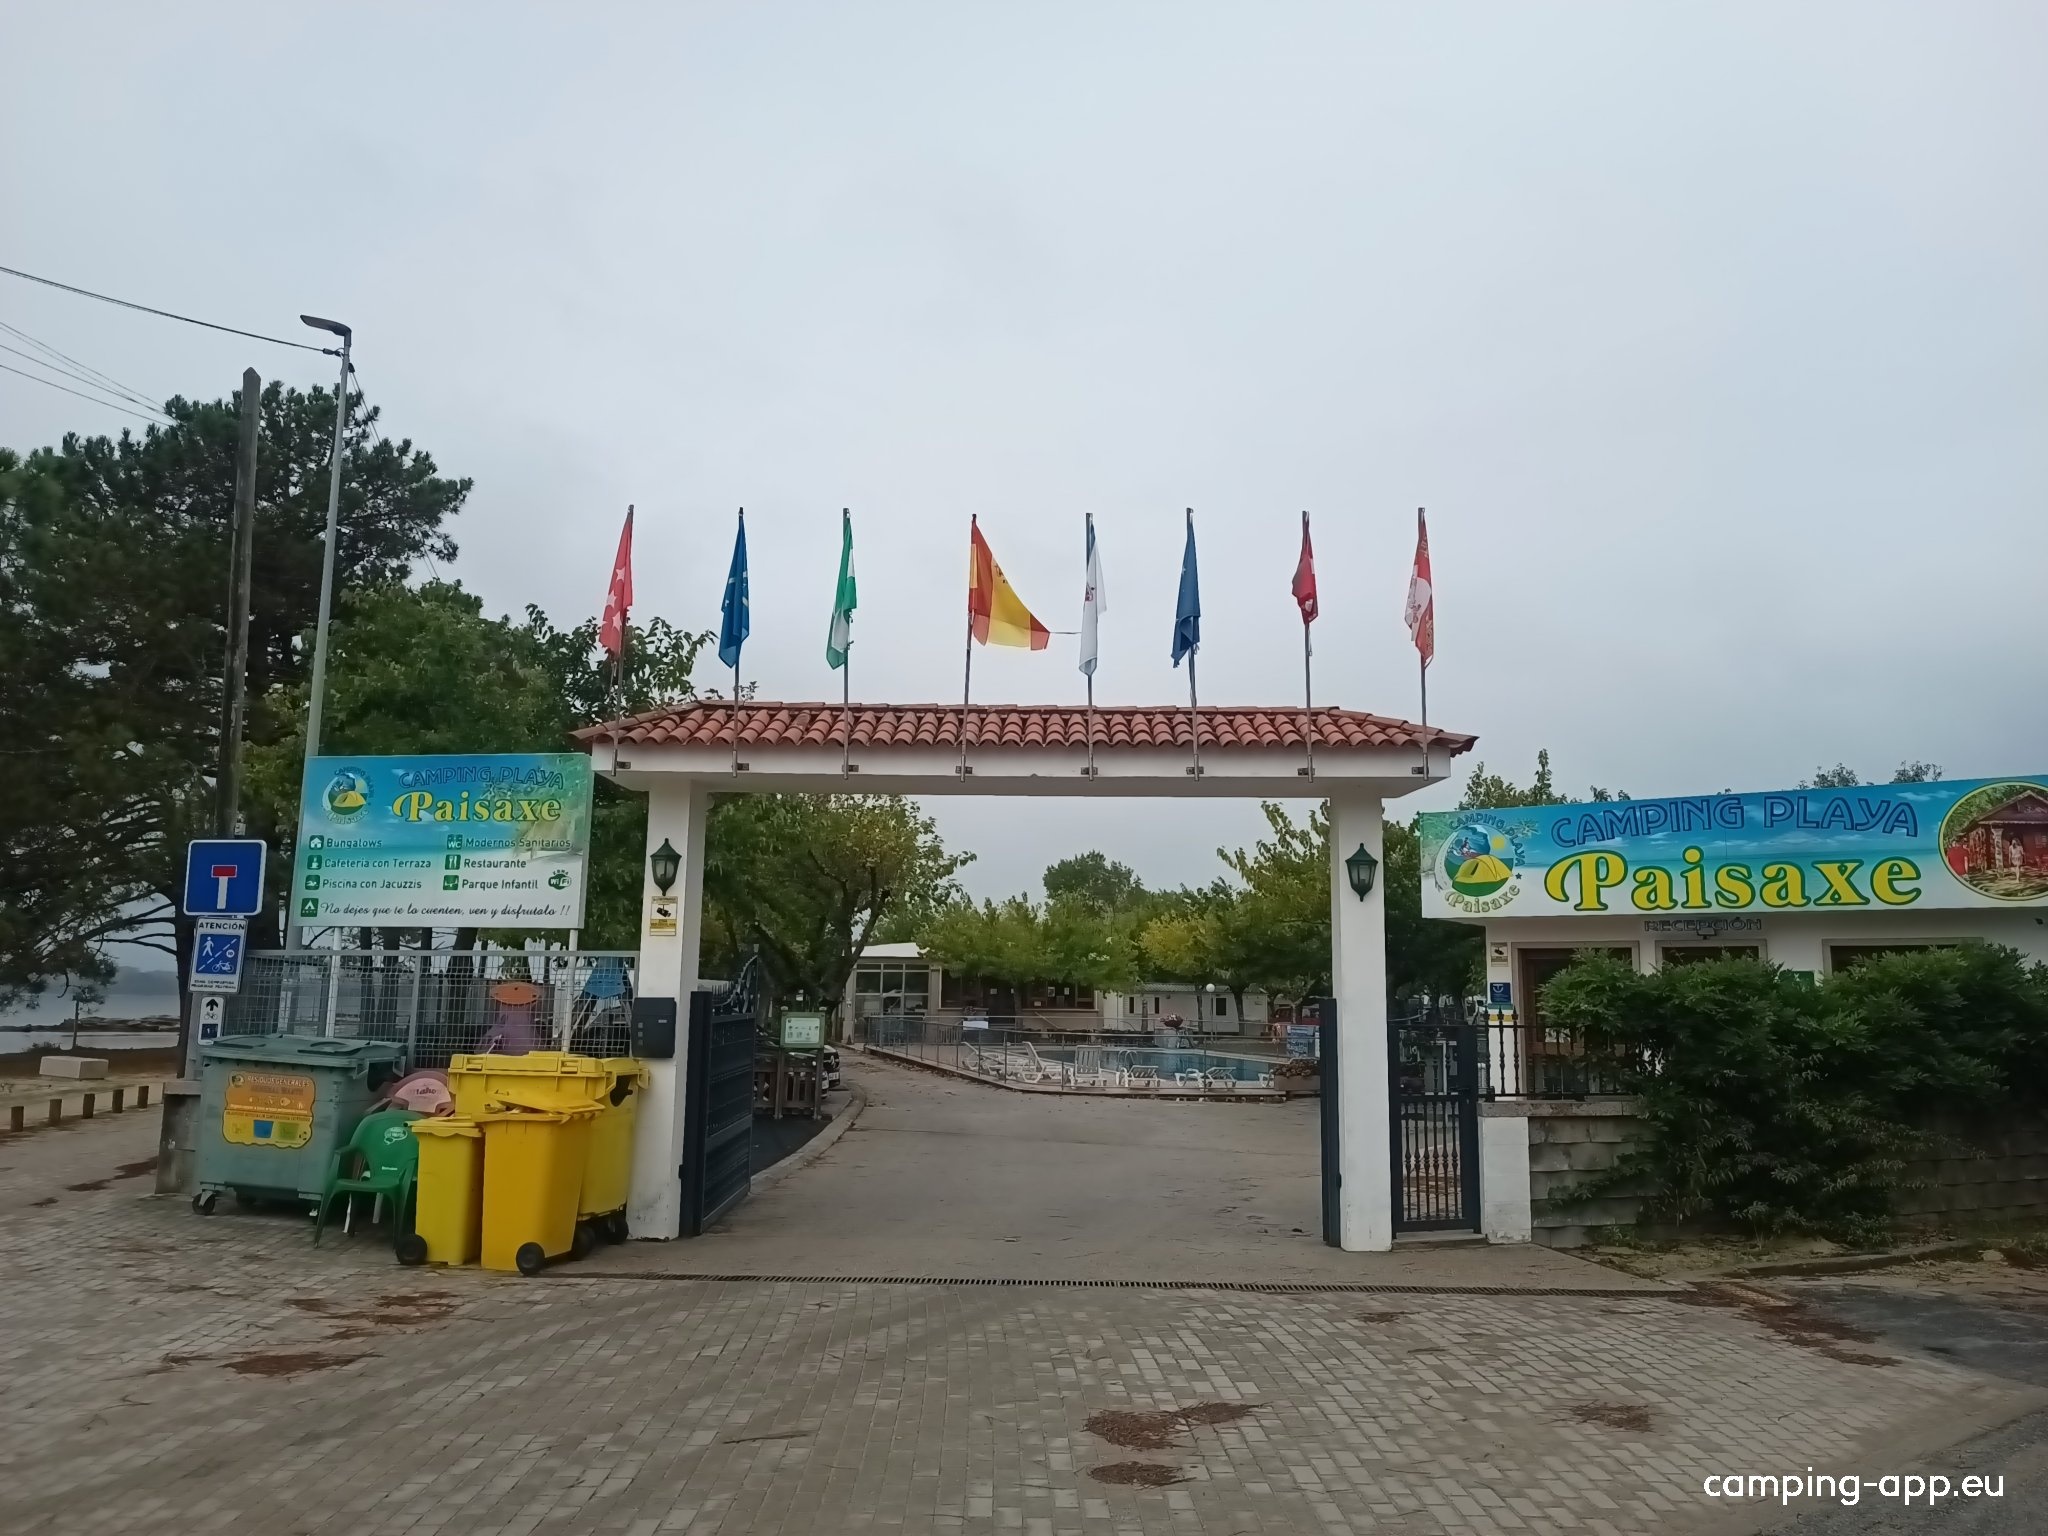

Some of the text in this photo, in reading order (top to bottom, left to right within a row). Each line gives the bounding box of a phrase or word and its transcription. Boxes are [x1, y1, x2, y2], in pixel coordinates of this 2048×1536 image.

[399, 766, 492, 788] CAMPING
[499, 766, 564, 790] PLAYA
[391, 790, 562, 822] Paisaxe
[1551, 796, 1918, 848] CAMPING PLAYA
[326, 838, 383, 849] Bungalows
[465, 838, 571, 848] Modernos Sanitarios
[1448, 812, 1526, 867] CAMPING PLAYA
[372, 860, 389, 868] con
[393, 858, 432, 868] Terraza
[463, 858, 527, 868] Restaurante
[322, 878, 422, 889] Piscina con Jacuzzis
[461, 879, 538, 891] Parque Infantil
[1543, 845, 1922, 912] Paisaxe
[1444, 884, 1521, 913] Paisaxe
[320, 902, 340, 914] No
[343, 903, 370, 916] dejes
[372, 906, 391, 917] que
[394, 904, 404, 914] te
[407, 902, 419, 914] lo
[468, 907, 488, 915] ven
[490, 907, 498, 919] y
[198, 921, 245, 930] ATENCIÓN
[1643, 916, 1762, 931] RECEPCIÓN
